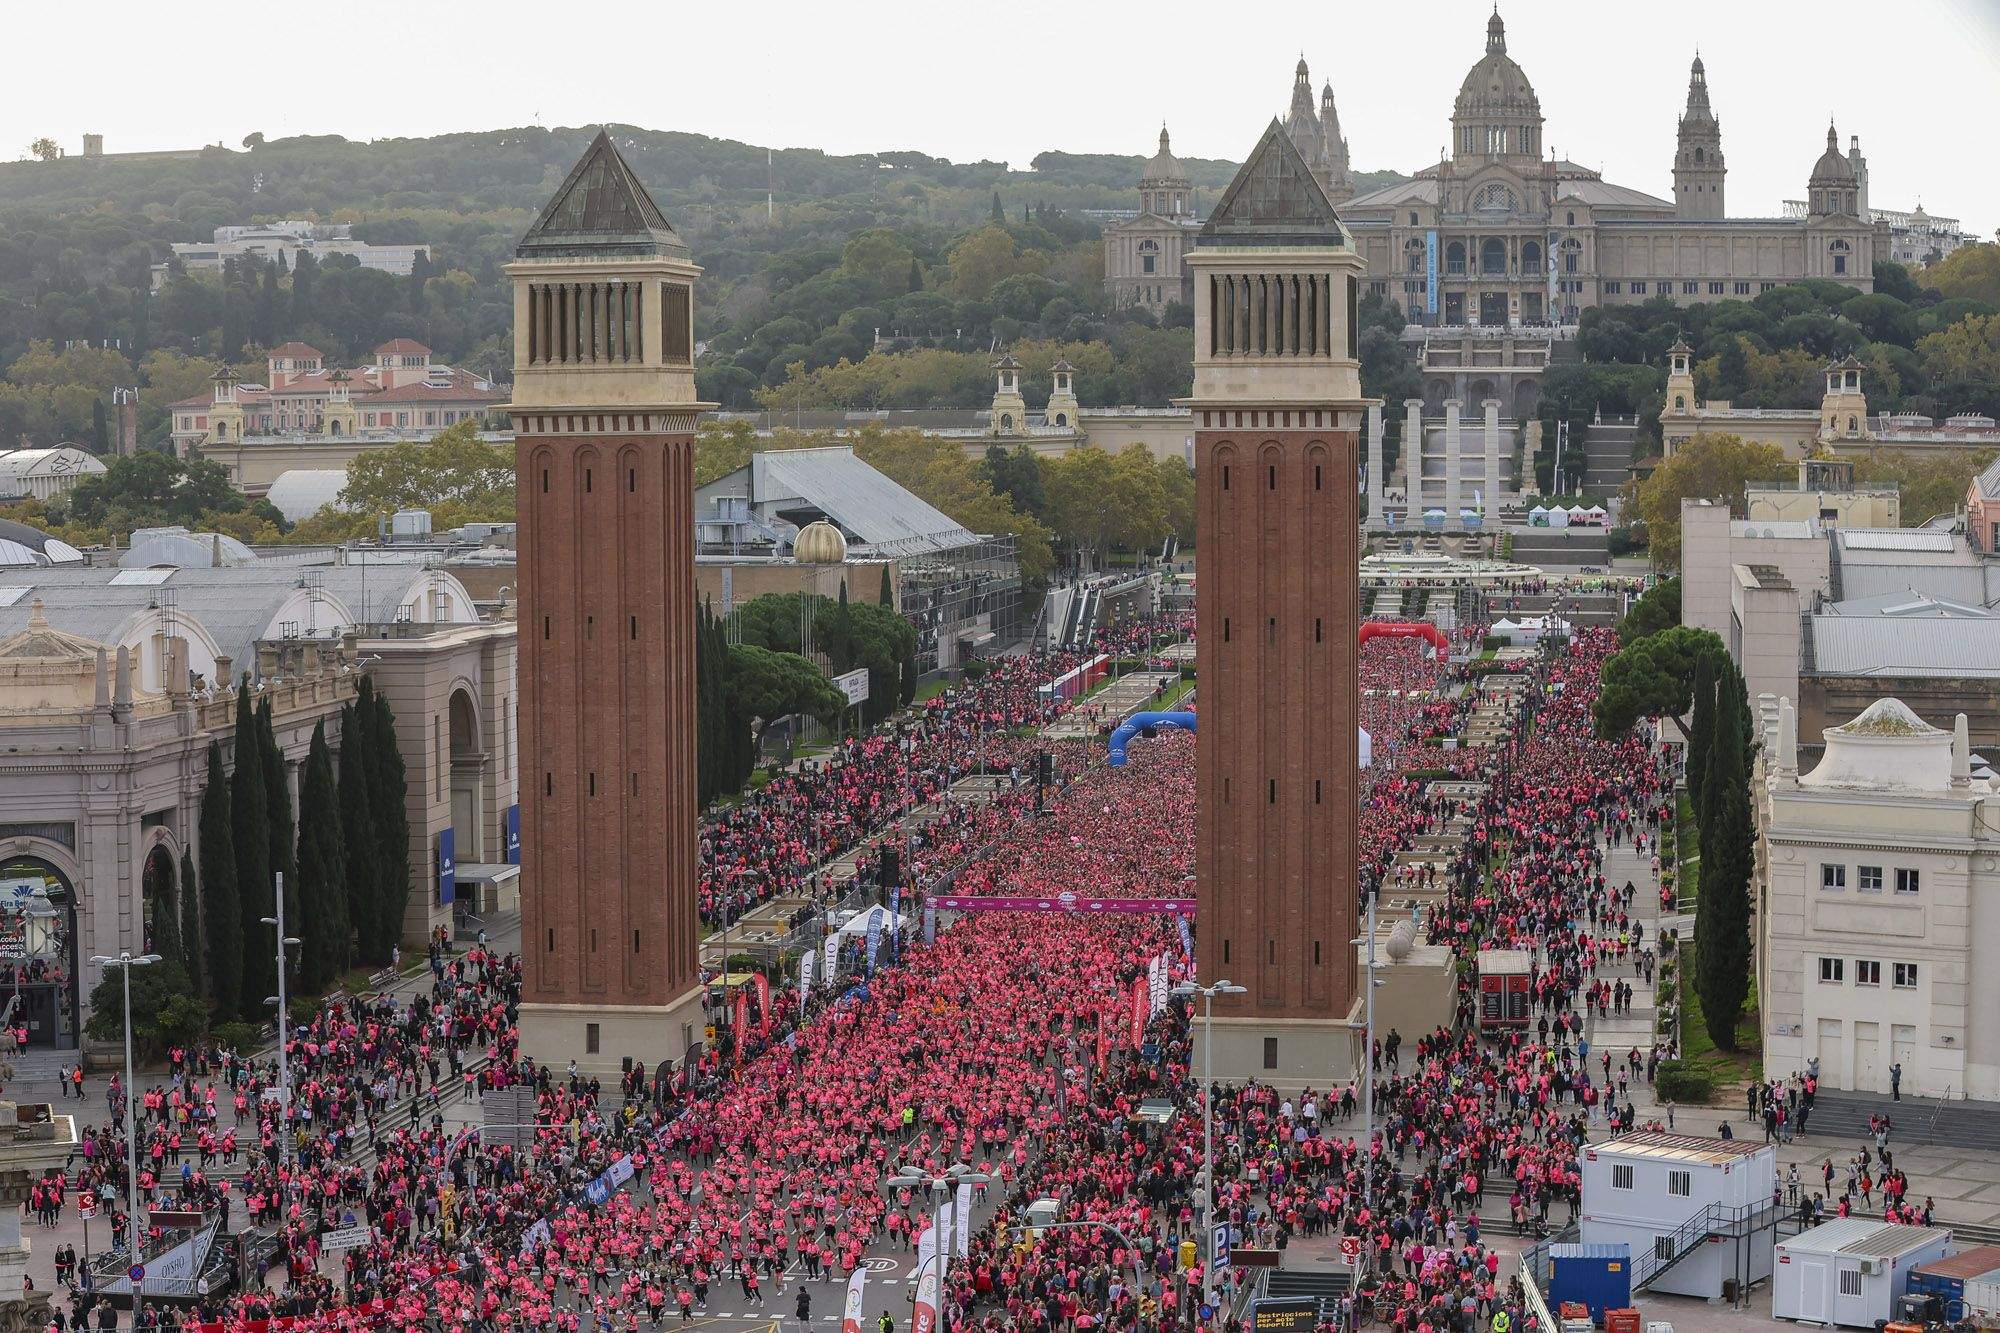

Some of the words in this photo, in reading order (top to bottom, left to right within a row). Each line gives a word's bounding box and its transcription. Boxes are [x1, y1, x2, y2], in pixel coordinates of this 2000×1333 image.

[1134, 988, 1143, 1021] Santander
[1214, 1227, 1227, 1259] P
[162, 1255, 185, 1279] OYSHO
[1257, 1311, 1313, 1319] Restriccions
[1257, 1321, 1295, 1329] esportiu
